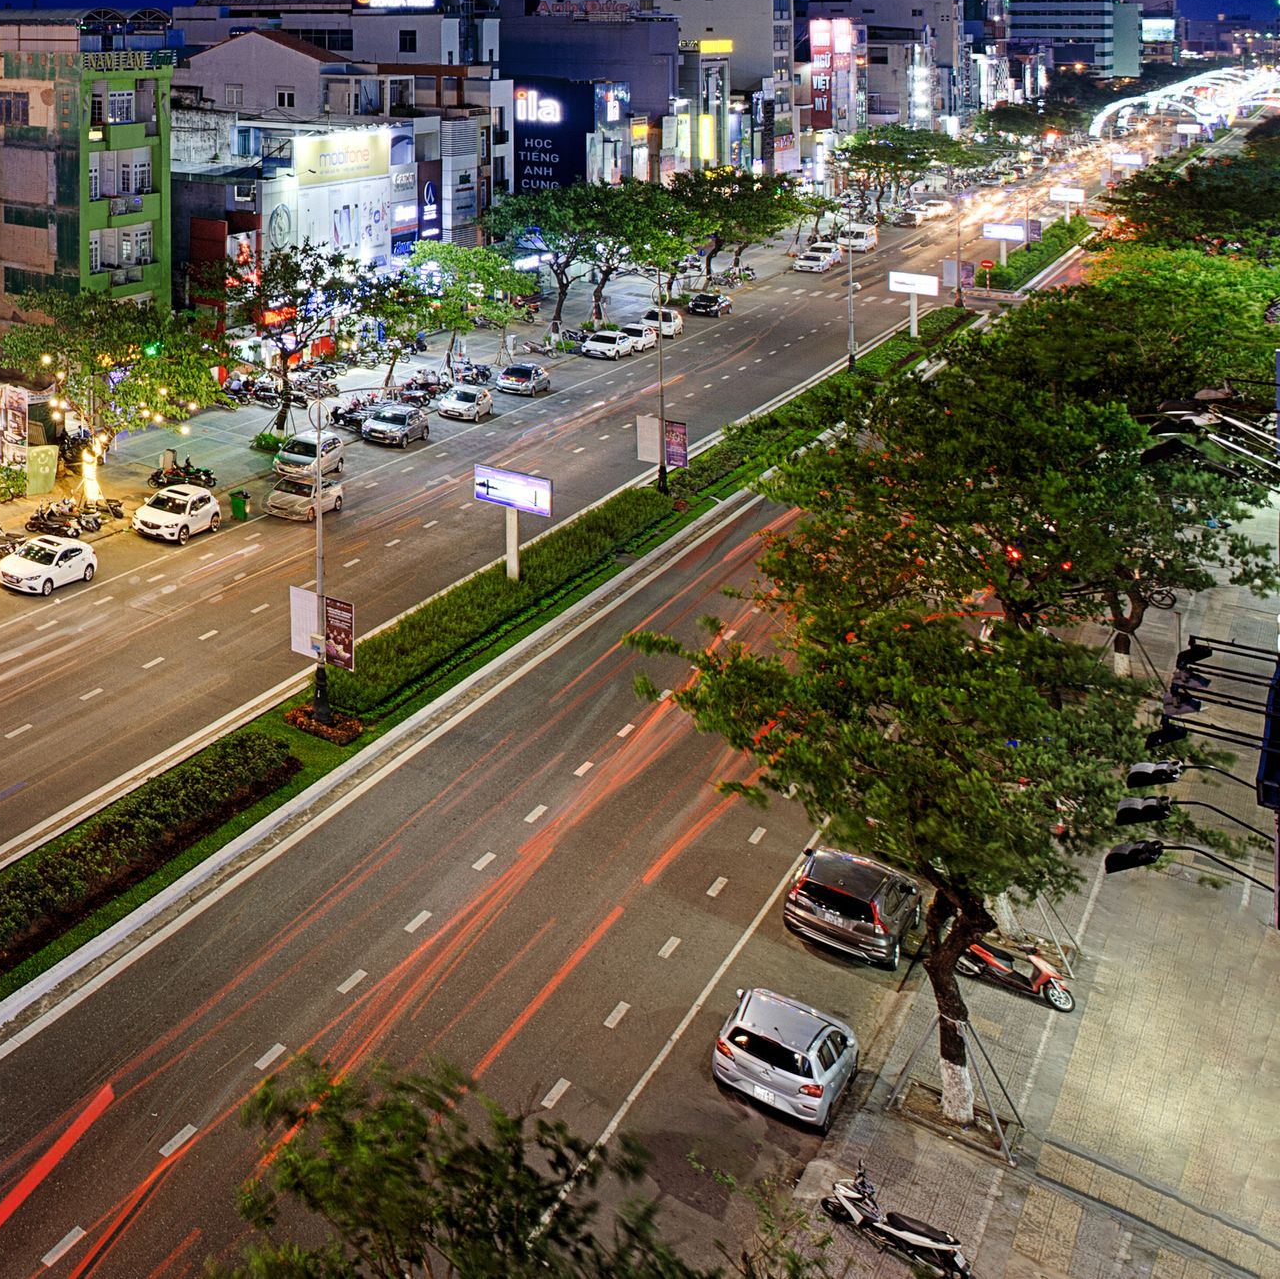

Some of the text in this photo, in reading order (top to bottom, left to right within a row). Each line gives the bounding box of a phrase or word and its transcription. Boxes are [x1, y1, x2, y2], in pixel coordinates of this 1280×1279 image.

[514, 88, 561, 122] ila
[319, 148, 370, 168] mobifone
[523, 165, 553, 176] ANH
